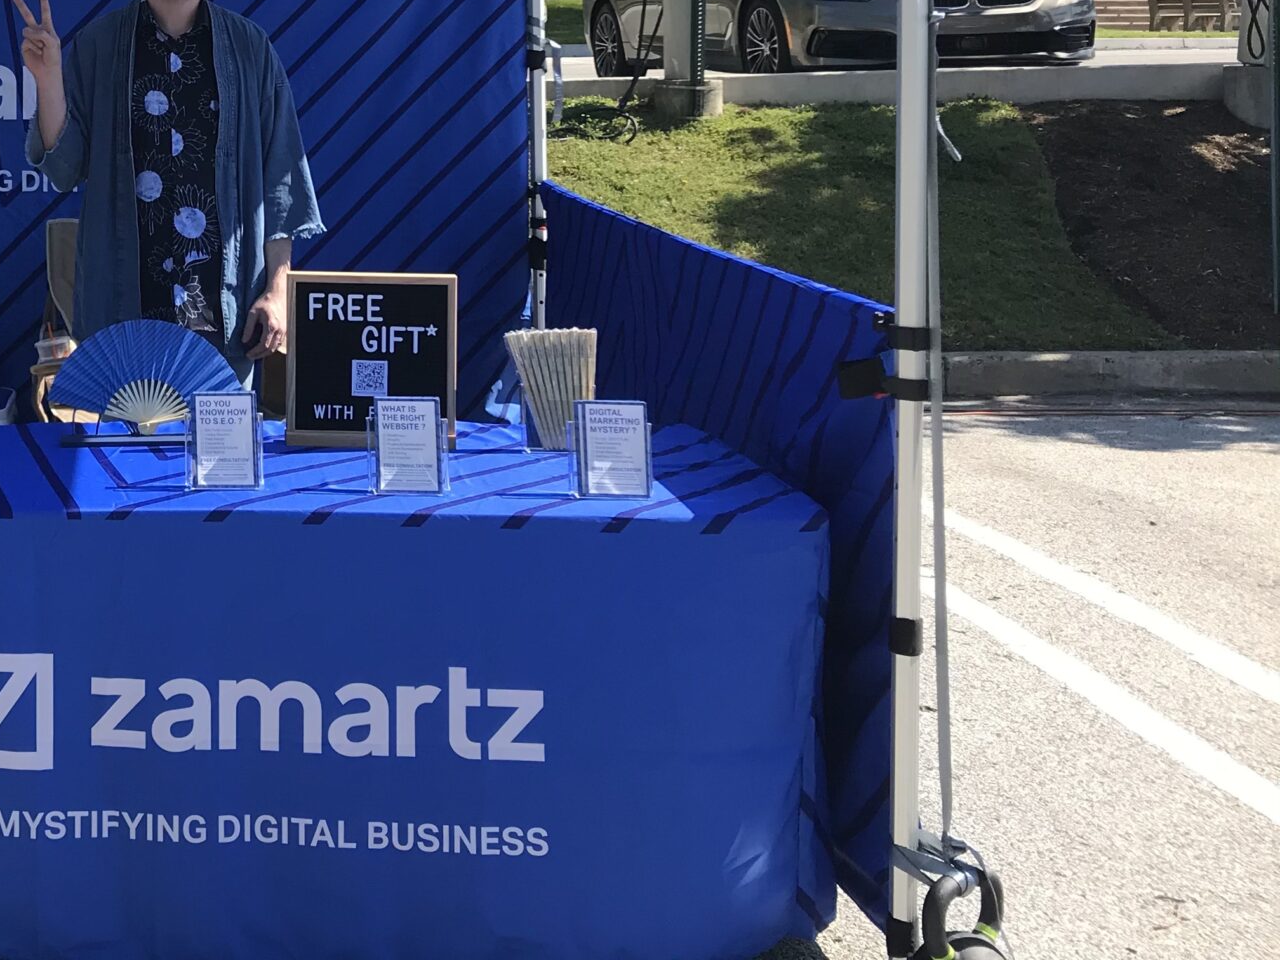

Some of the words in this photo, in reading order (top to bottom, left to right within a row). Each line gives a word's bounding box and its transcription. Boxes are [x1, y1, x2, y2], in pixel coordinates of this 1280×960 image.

[308, 292, 384, 322] FREE
[313, 404, 354, 420] WITH
[381, 405, 406, 413] WHAT
[589, 408, 623, 416] DIGITAL
[200, 417, 211, 425] TO
[400, 414, 426, 422] RIGHT
[589, 417, 640, 426] MARKETING
[590, 426, 630, 434] MYSTERY
[91, 666, 546, 762] zamartz
[218, 814, 357, 850] DIGITAL
[367, 821, 549, 857] BUSINESS
